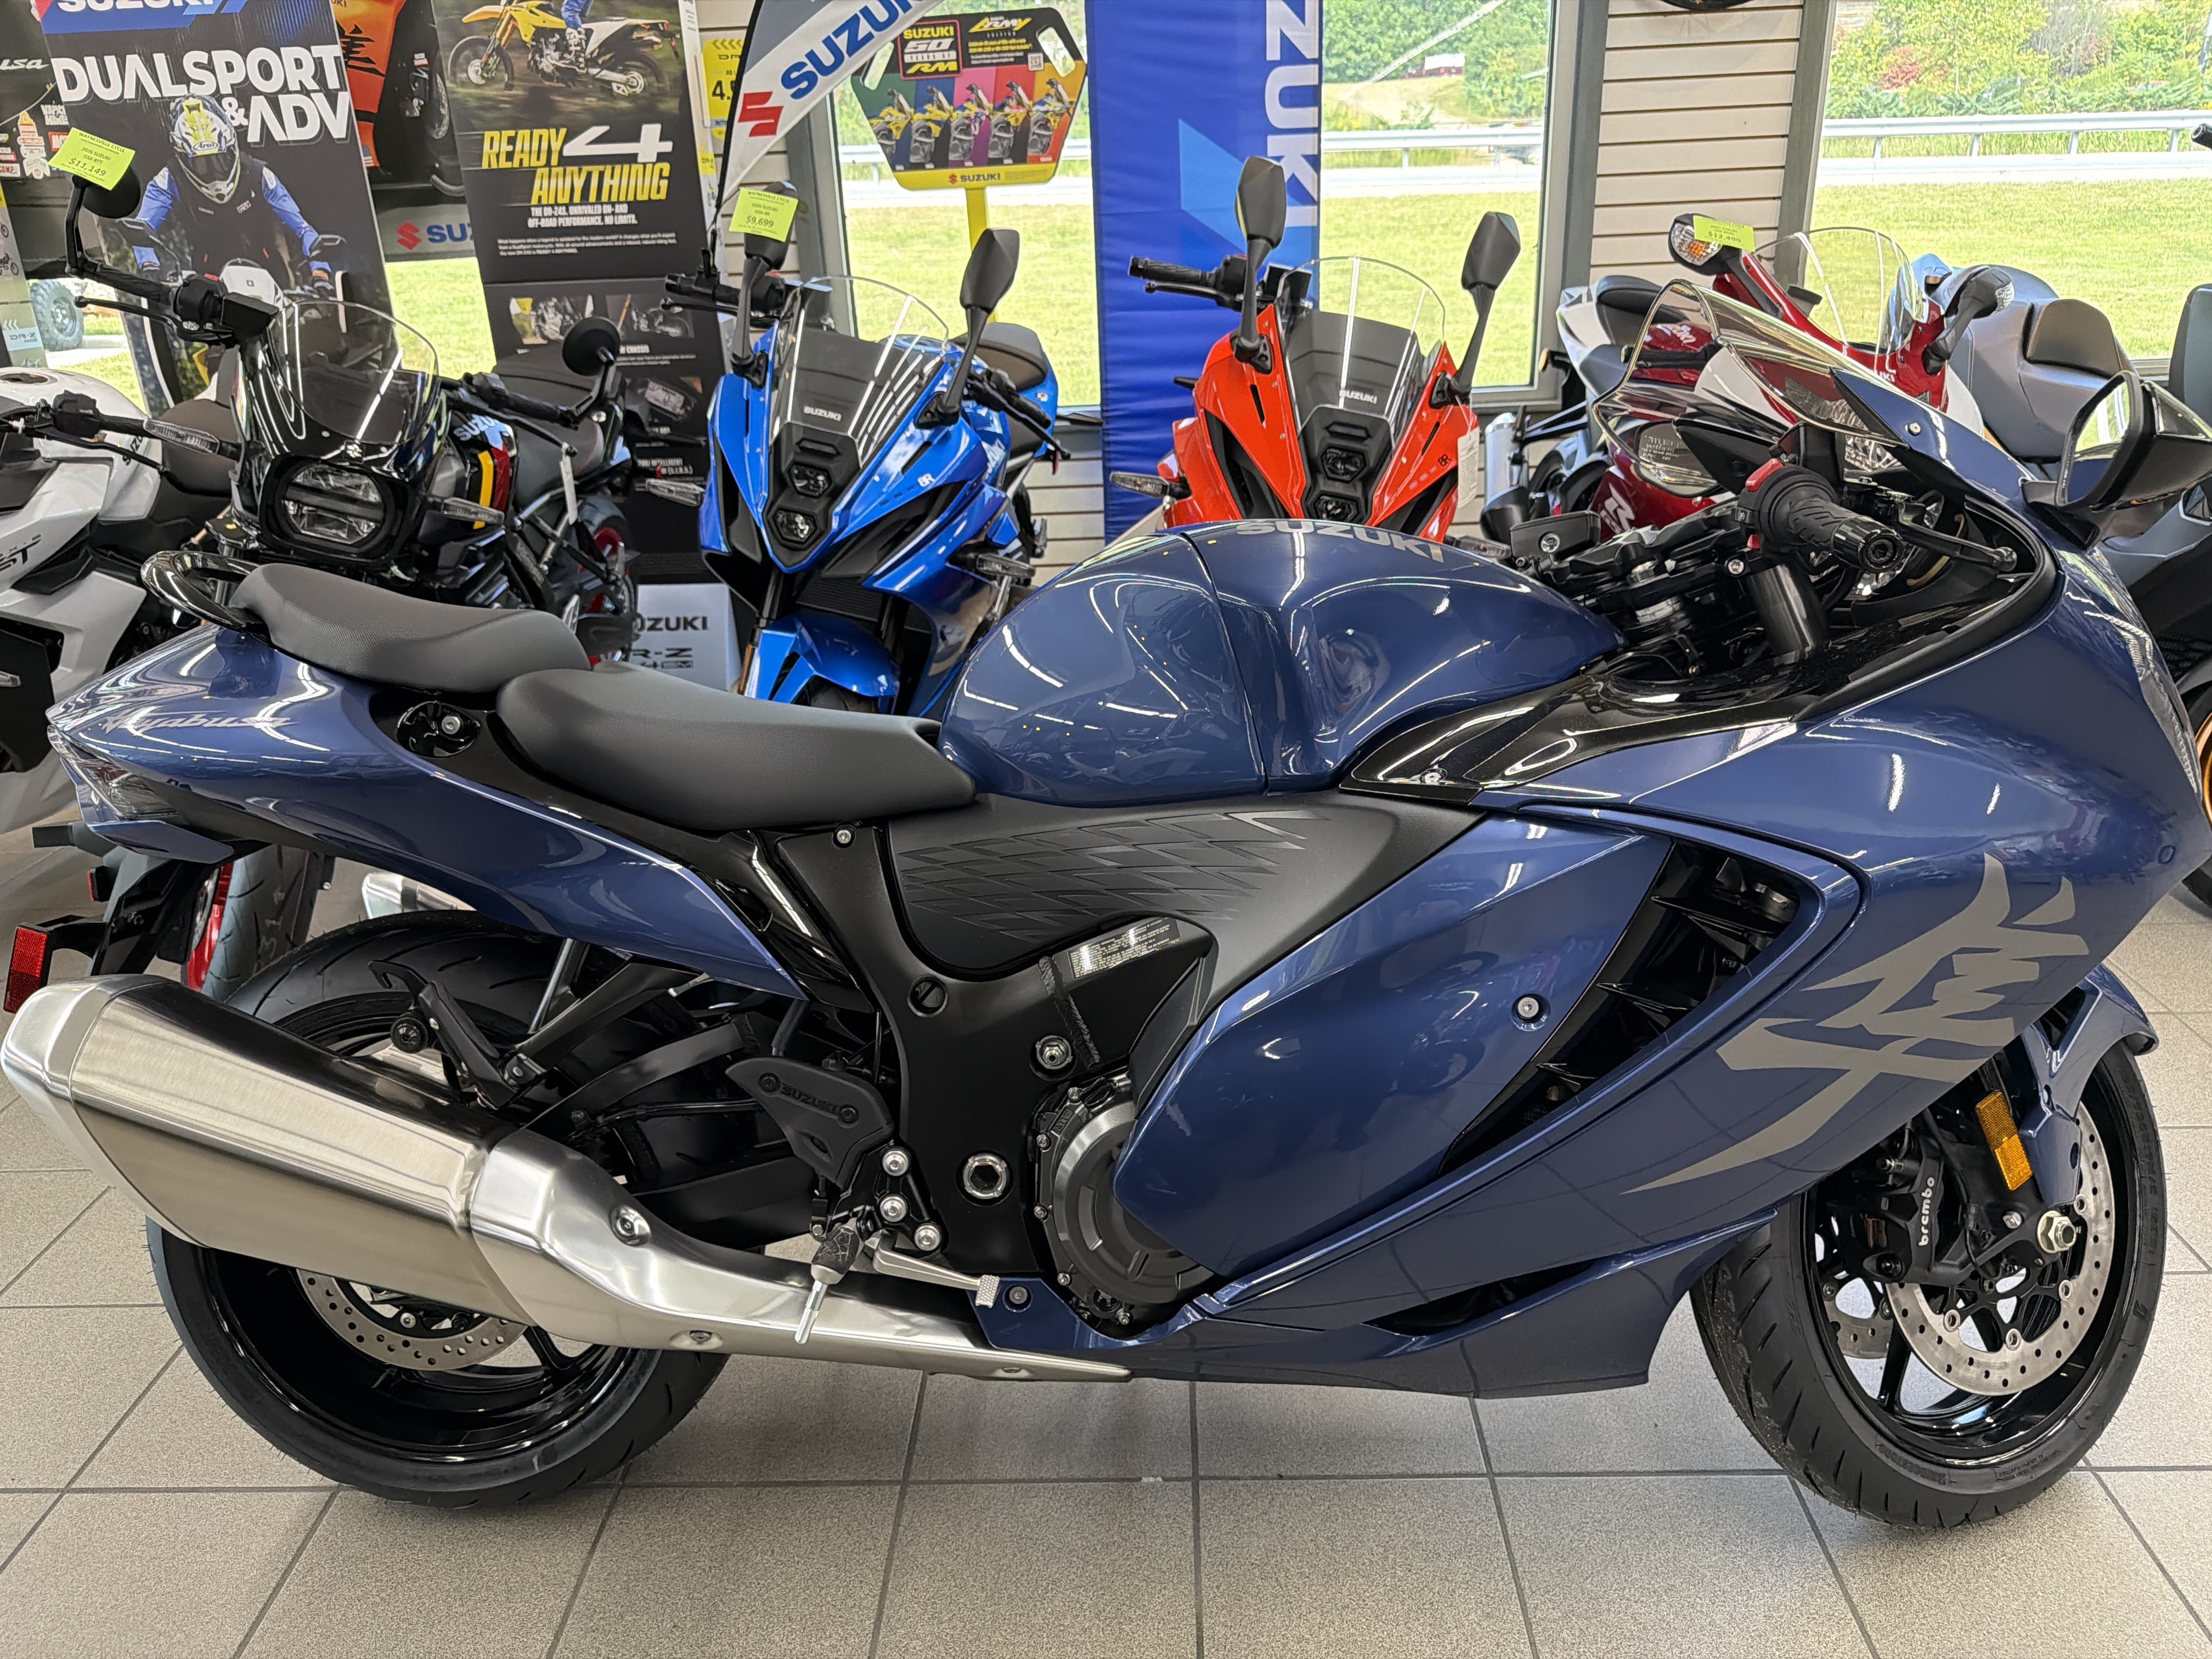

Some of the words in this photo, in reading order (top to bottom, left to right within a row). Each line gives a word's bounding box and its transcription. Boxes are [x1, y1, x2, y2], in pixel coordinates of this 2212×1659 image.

[903, 26, 955, 40] SUZUKI
[905, 38, 954, 53] 50
[907, 61, 957, 74] RM
[78, 132, 110, 147] WAYNESVILLE
[111, 144, 126, 153] CYCLE
[482, 128, 567, 169] READY
[563, 124, 673, 162] 4
[93, 151, 111, 161] SUZUKI
[68, 157, 106, 177] $11,149
[531, 162, 670, 205] ANYTHING
[961, 173, 1001, 183] SUZUKI
[746, 215, 774, 228] $9,699
[1339, 389, 1378, 404] SUZUKI
[803, 405, 842, 421] SUZUKI
[1236, 521, 1444, 563] SUZUKI
[1918, 1177, 1935, 1246] brembo
